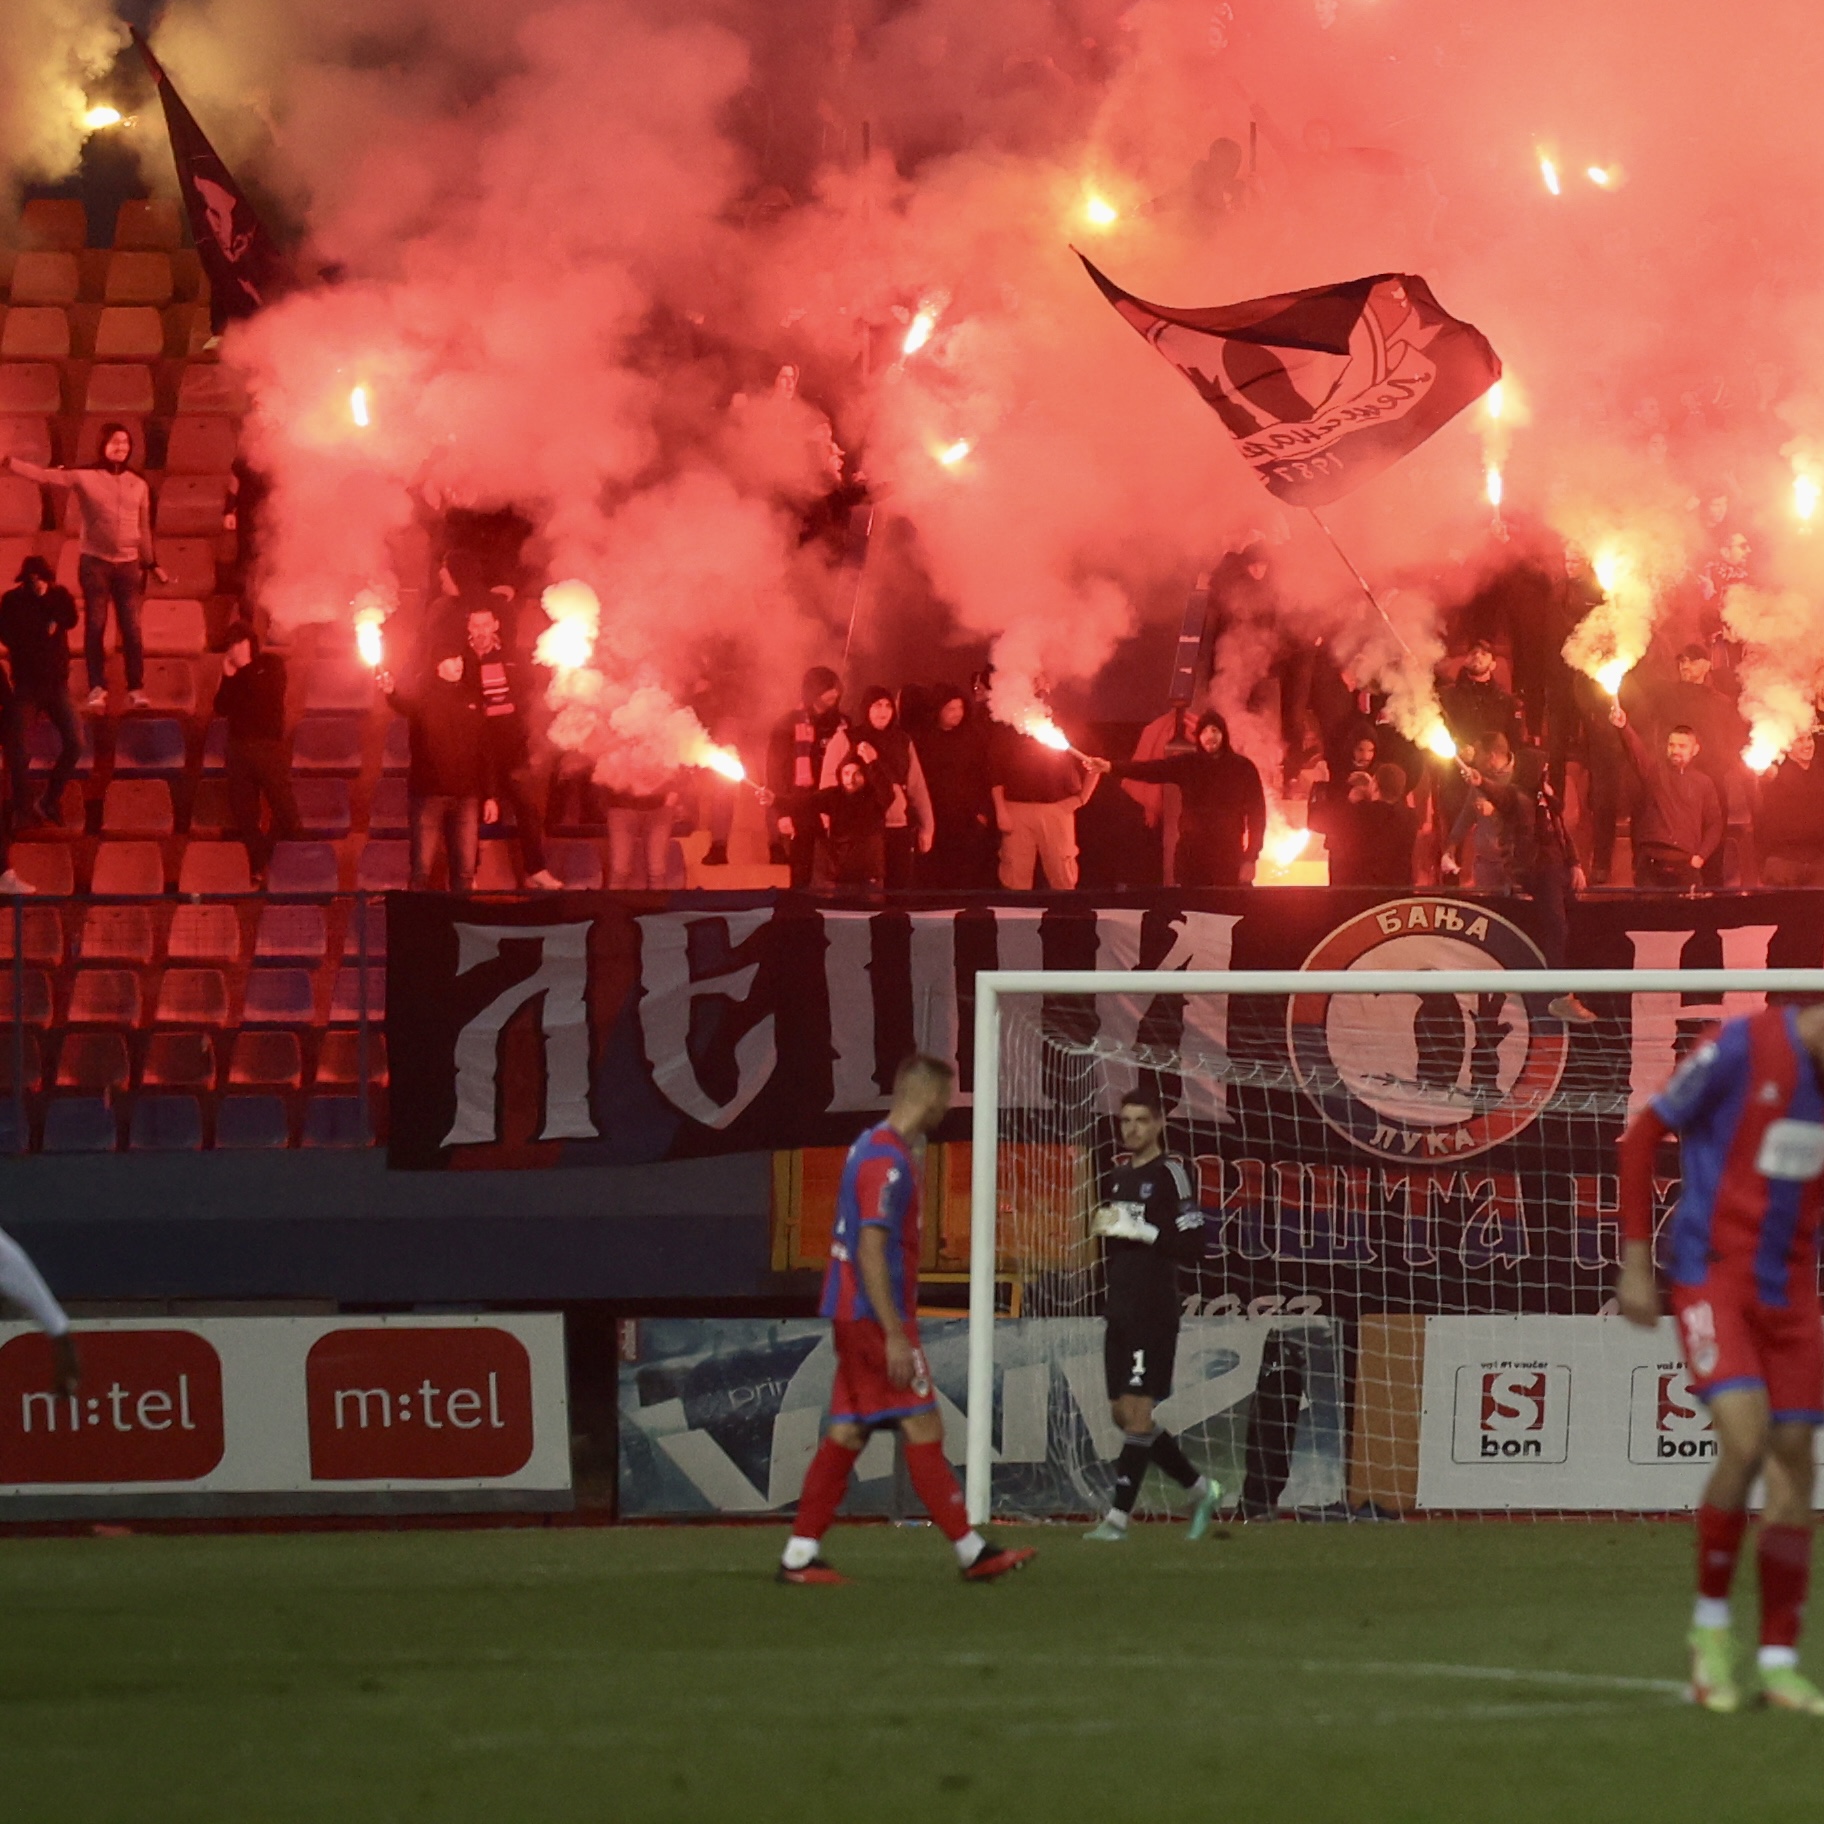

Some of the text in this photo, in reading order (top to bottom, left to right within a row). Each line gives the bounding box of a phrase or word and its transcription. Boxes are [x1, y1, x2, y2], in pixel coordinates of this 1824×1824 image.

[1376, 905, 1489, 942] БАЊА
[1369, 1125, 1475, 1155] ЛУКА
[1132, 1349, 1146, 1375] 1
[334, 1371, 505, 1430] m:tel
[1481, 1435, 1541, 1457] bon
